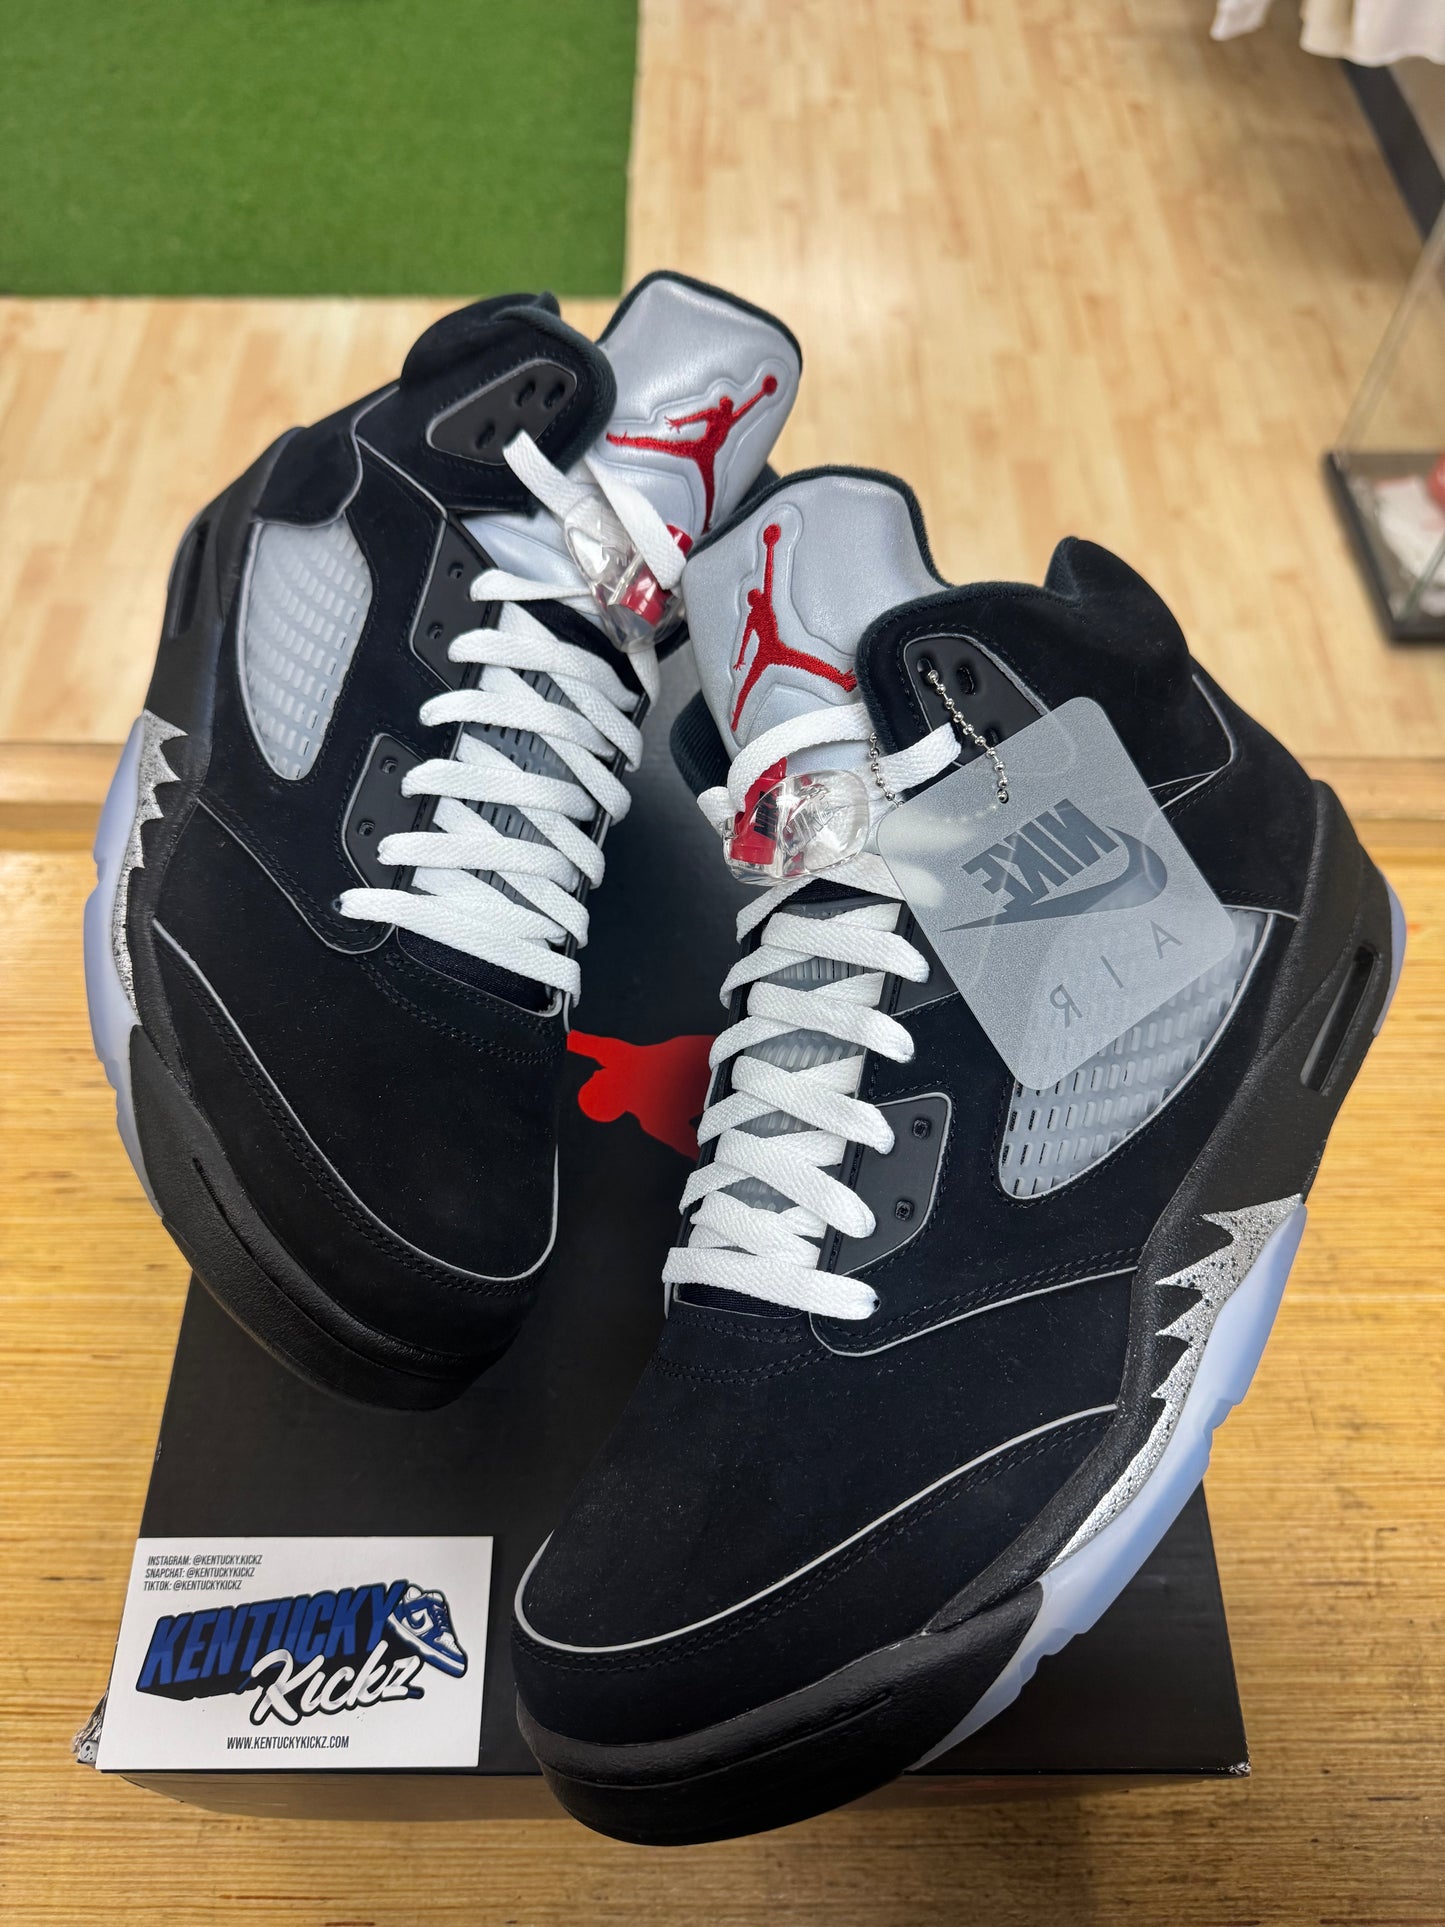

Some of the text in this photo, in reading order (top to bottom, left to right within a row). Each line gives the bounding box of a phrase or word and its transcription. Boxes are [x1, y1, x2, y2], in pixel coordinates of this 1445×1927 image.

[147, 1554, 263, 1566] INSTAGRAM: @KENTUCKY.KICKZ
[145, 1567, 255, 1579] SNAPCHAT: @KENTUCKYKICKZ
[143, 1580, 243, 1591] TIKTOK: @KENTUCKYKICKZ
[137, 1581, 410, 1690] KENTUCKY
[250, 1639, 422, 1724] Kickz
[226, 1735, 350, 1750] WWW.KENTUCKYKICKZ.COM
